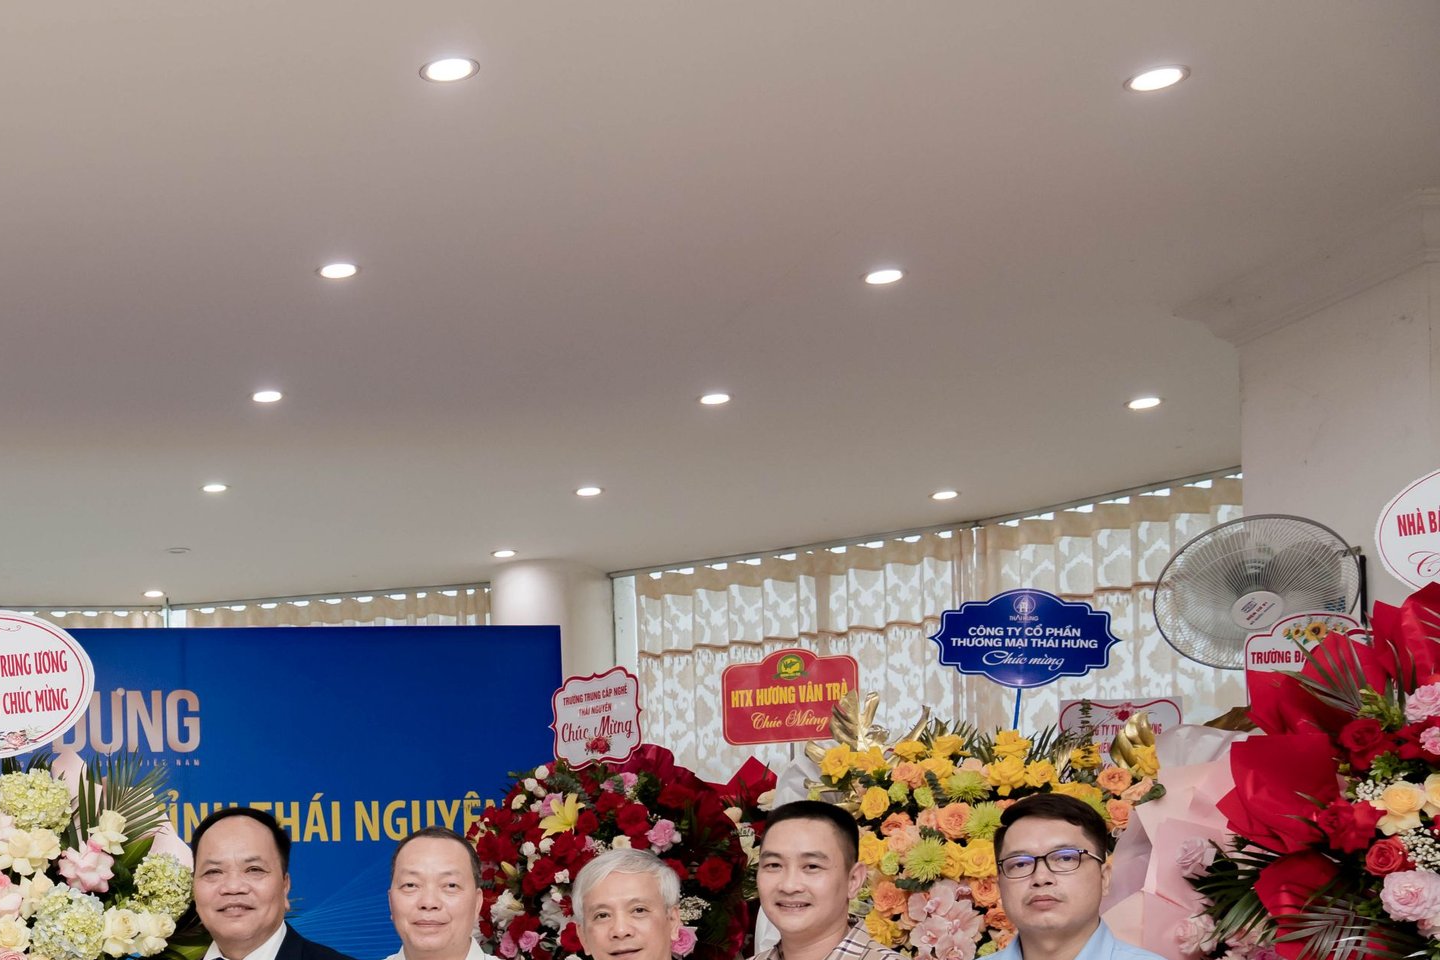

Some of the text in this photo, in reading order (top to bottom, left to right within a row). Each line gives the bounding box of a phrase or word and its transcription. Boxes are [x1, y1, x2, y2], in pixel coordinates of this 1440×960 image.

[1397, 507, 1426, 537] NHÀ
[968, 624, 1004, 636] CÔNG
[1007, 627, 1022, 636] TY
[1024, 624, 1043, 637] CỔ
[950, 637, 1098, 649] THƯƠNG MẠI THÁI HƯNG
[34, 650, 68, 674] ƯƠNG
[982, 650, 1065, 671] Chúc mừng
[1250, 648, 1291, 664] TRƯỜNG
[3, 686, 33, 715] CHÚC
[34, 683, 69, 712] MỪNG
[731, 689, 753, 708] HTX
[756, 685, 796, 706] HƯƠNG
[799, 681, 823, 703] VÂN
[561, 715, 634, 743] Chúc Mừng
[751, 709, 829, 732] Chúc Mừng
[355, 790, 506, 842] NGUYÊ
